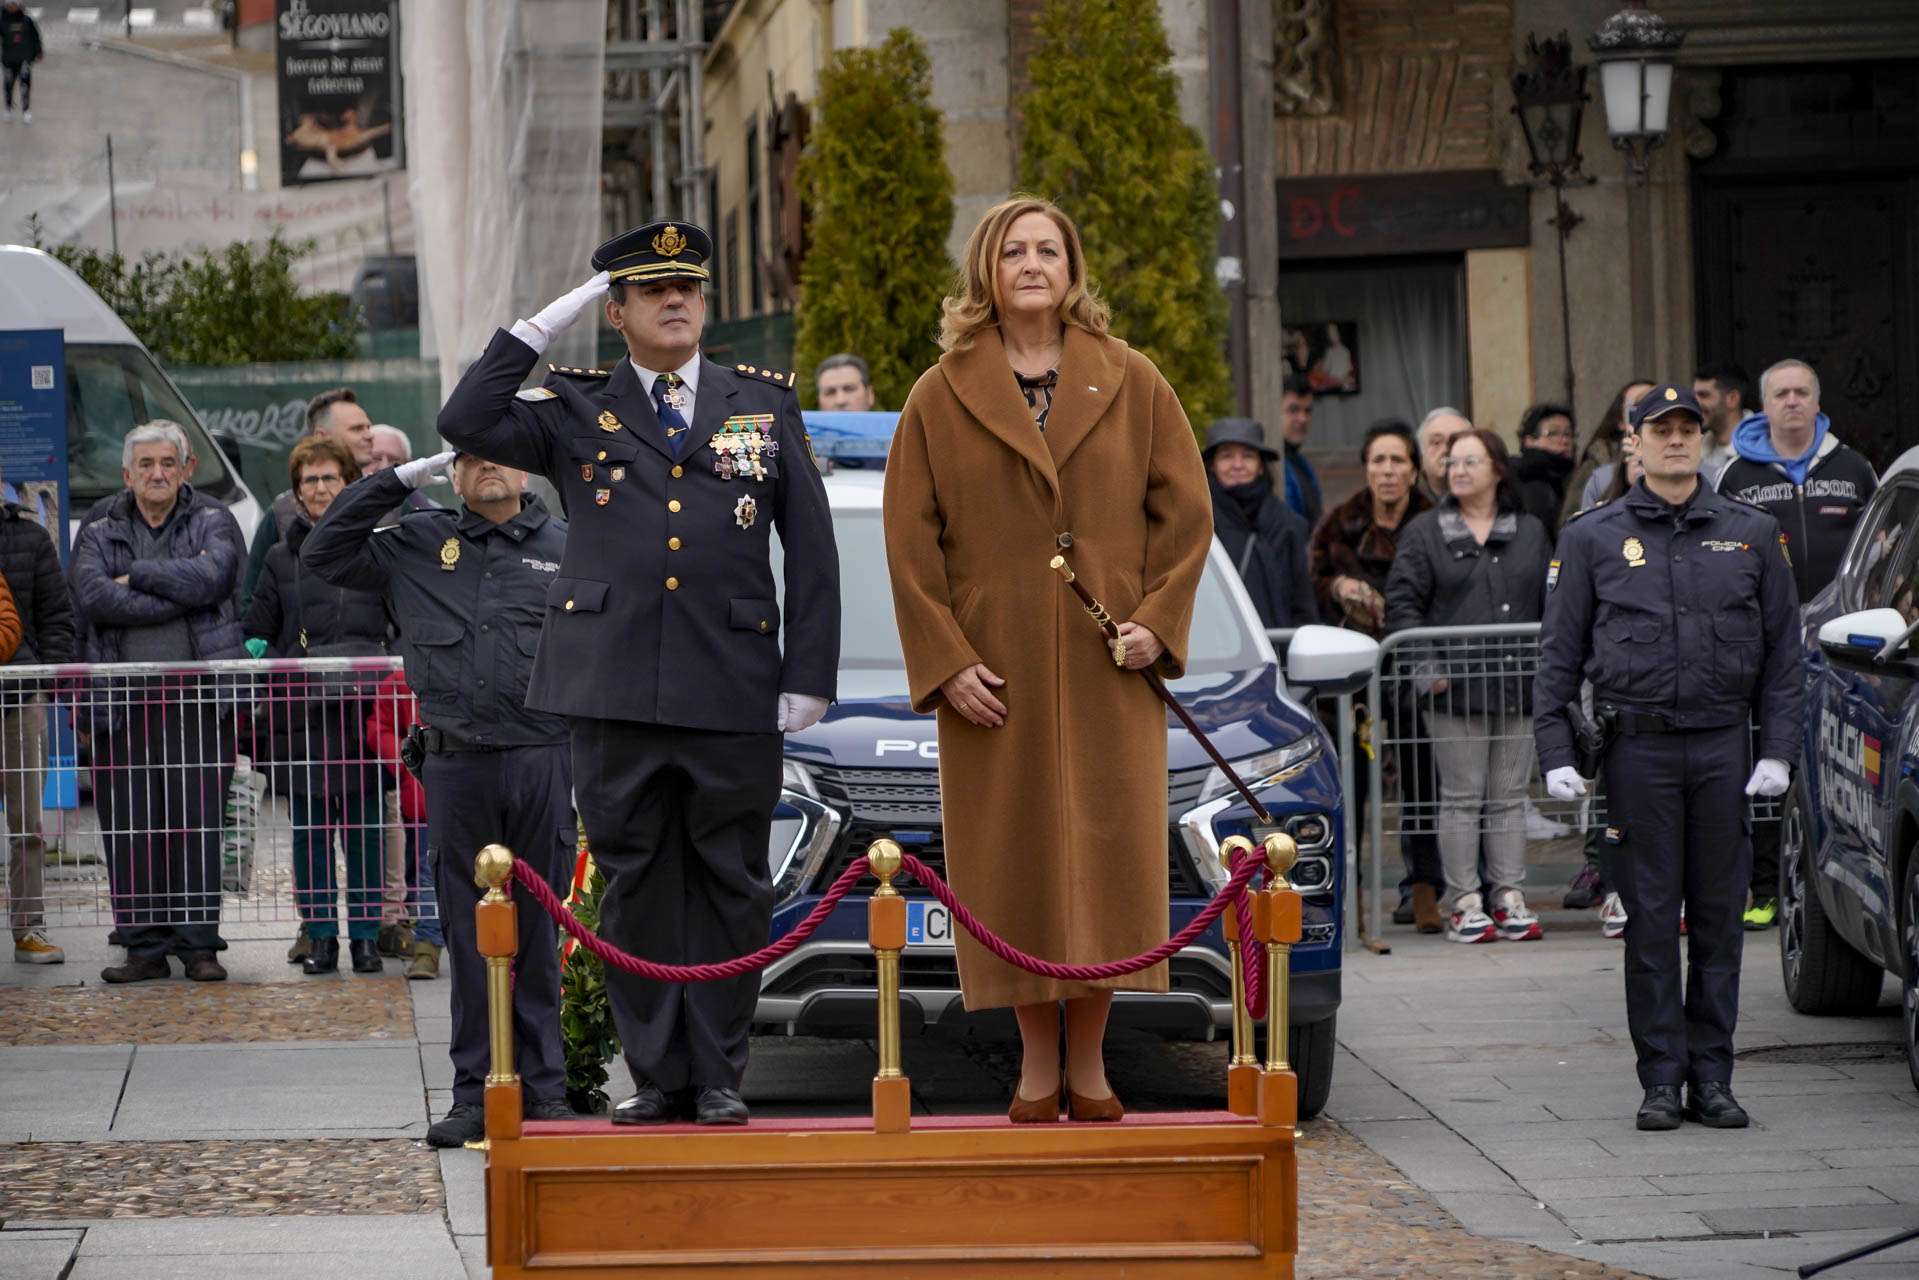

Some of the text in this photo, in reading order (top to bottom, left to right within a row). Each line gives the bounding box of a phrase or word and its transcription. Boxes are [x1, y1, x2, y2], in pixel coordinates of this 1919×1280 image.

[279, 11, 389, 39] SEGOVIANO
[330, 55, 349, 74] de
[307, 75, 364, 94] taberna
[1739, 477, 1857, 504] Morrison
[1700, 540, 1744, 549] POLICIA
[912, 927, 920, 937] E
